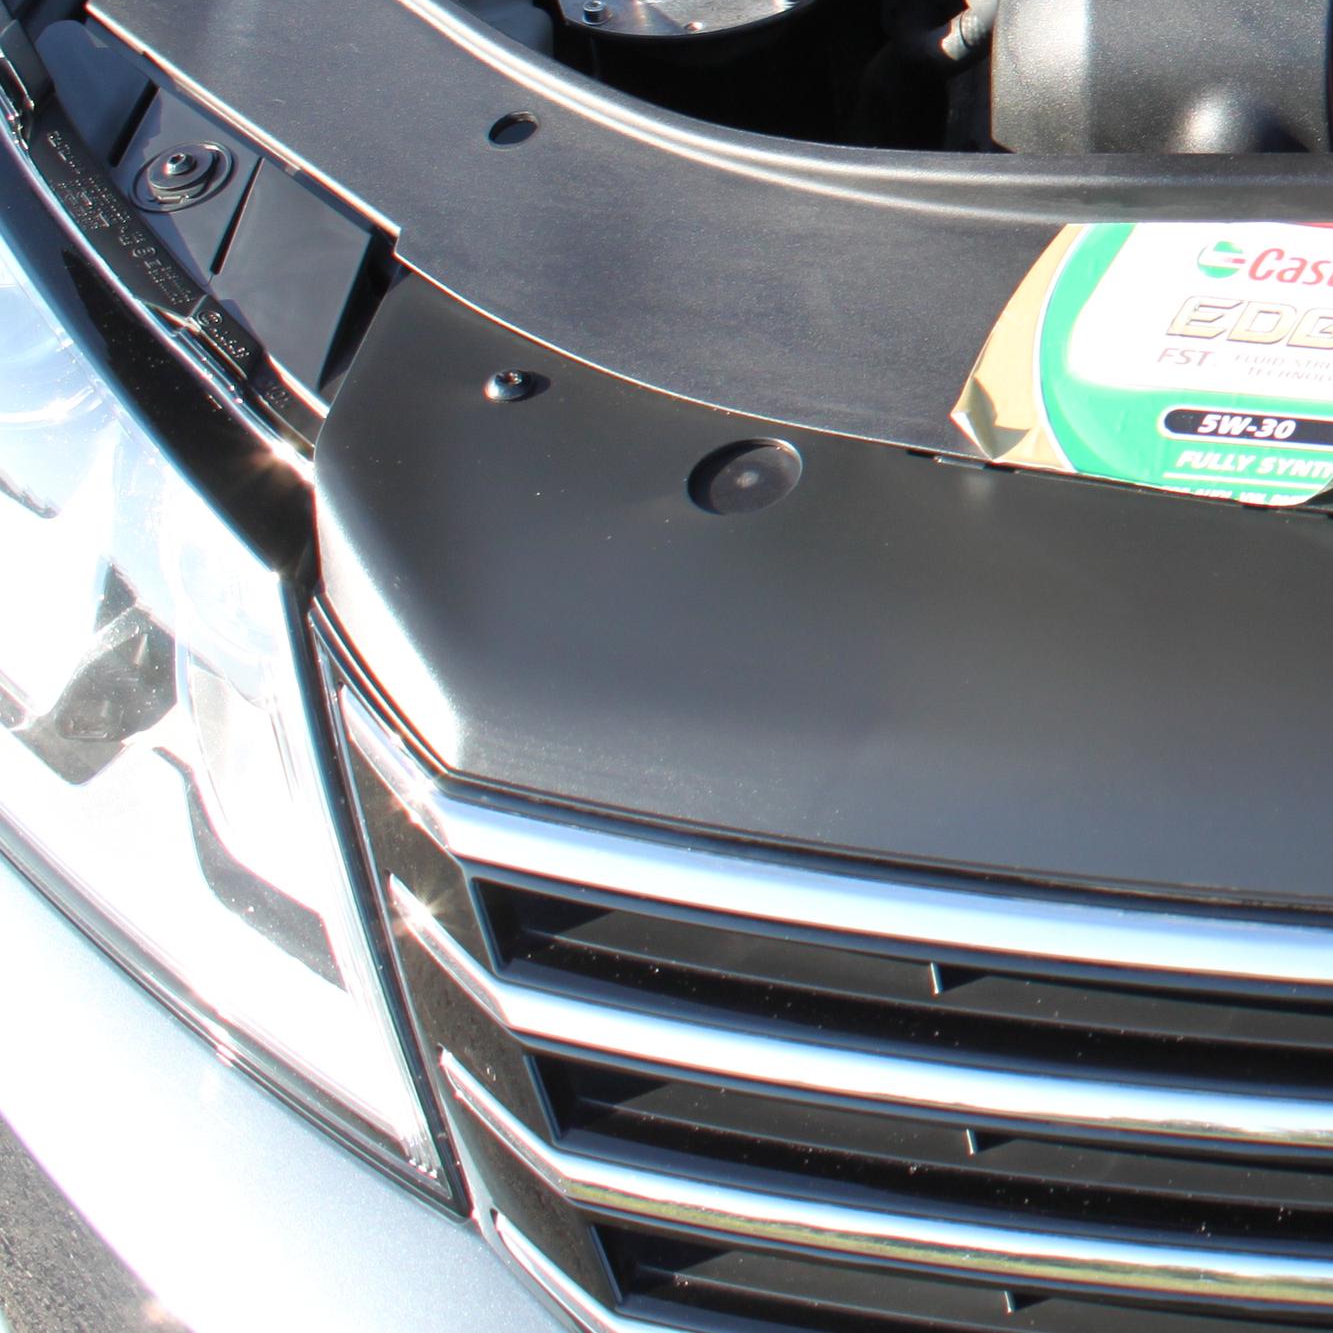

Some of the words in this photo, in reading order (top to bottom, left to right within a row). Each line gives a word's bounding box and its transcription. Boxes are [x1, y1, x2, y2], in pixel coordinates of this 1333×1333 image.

[1157, 347, 1215, 367] FST
[1197, 414, 1297, 439] 5W-30
[1176, 450, 1256, 471] FULLY
